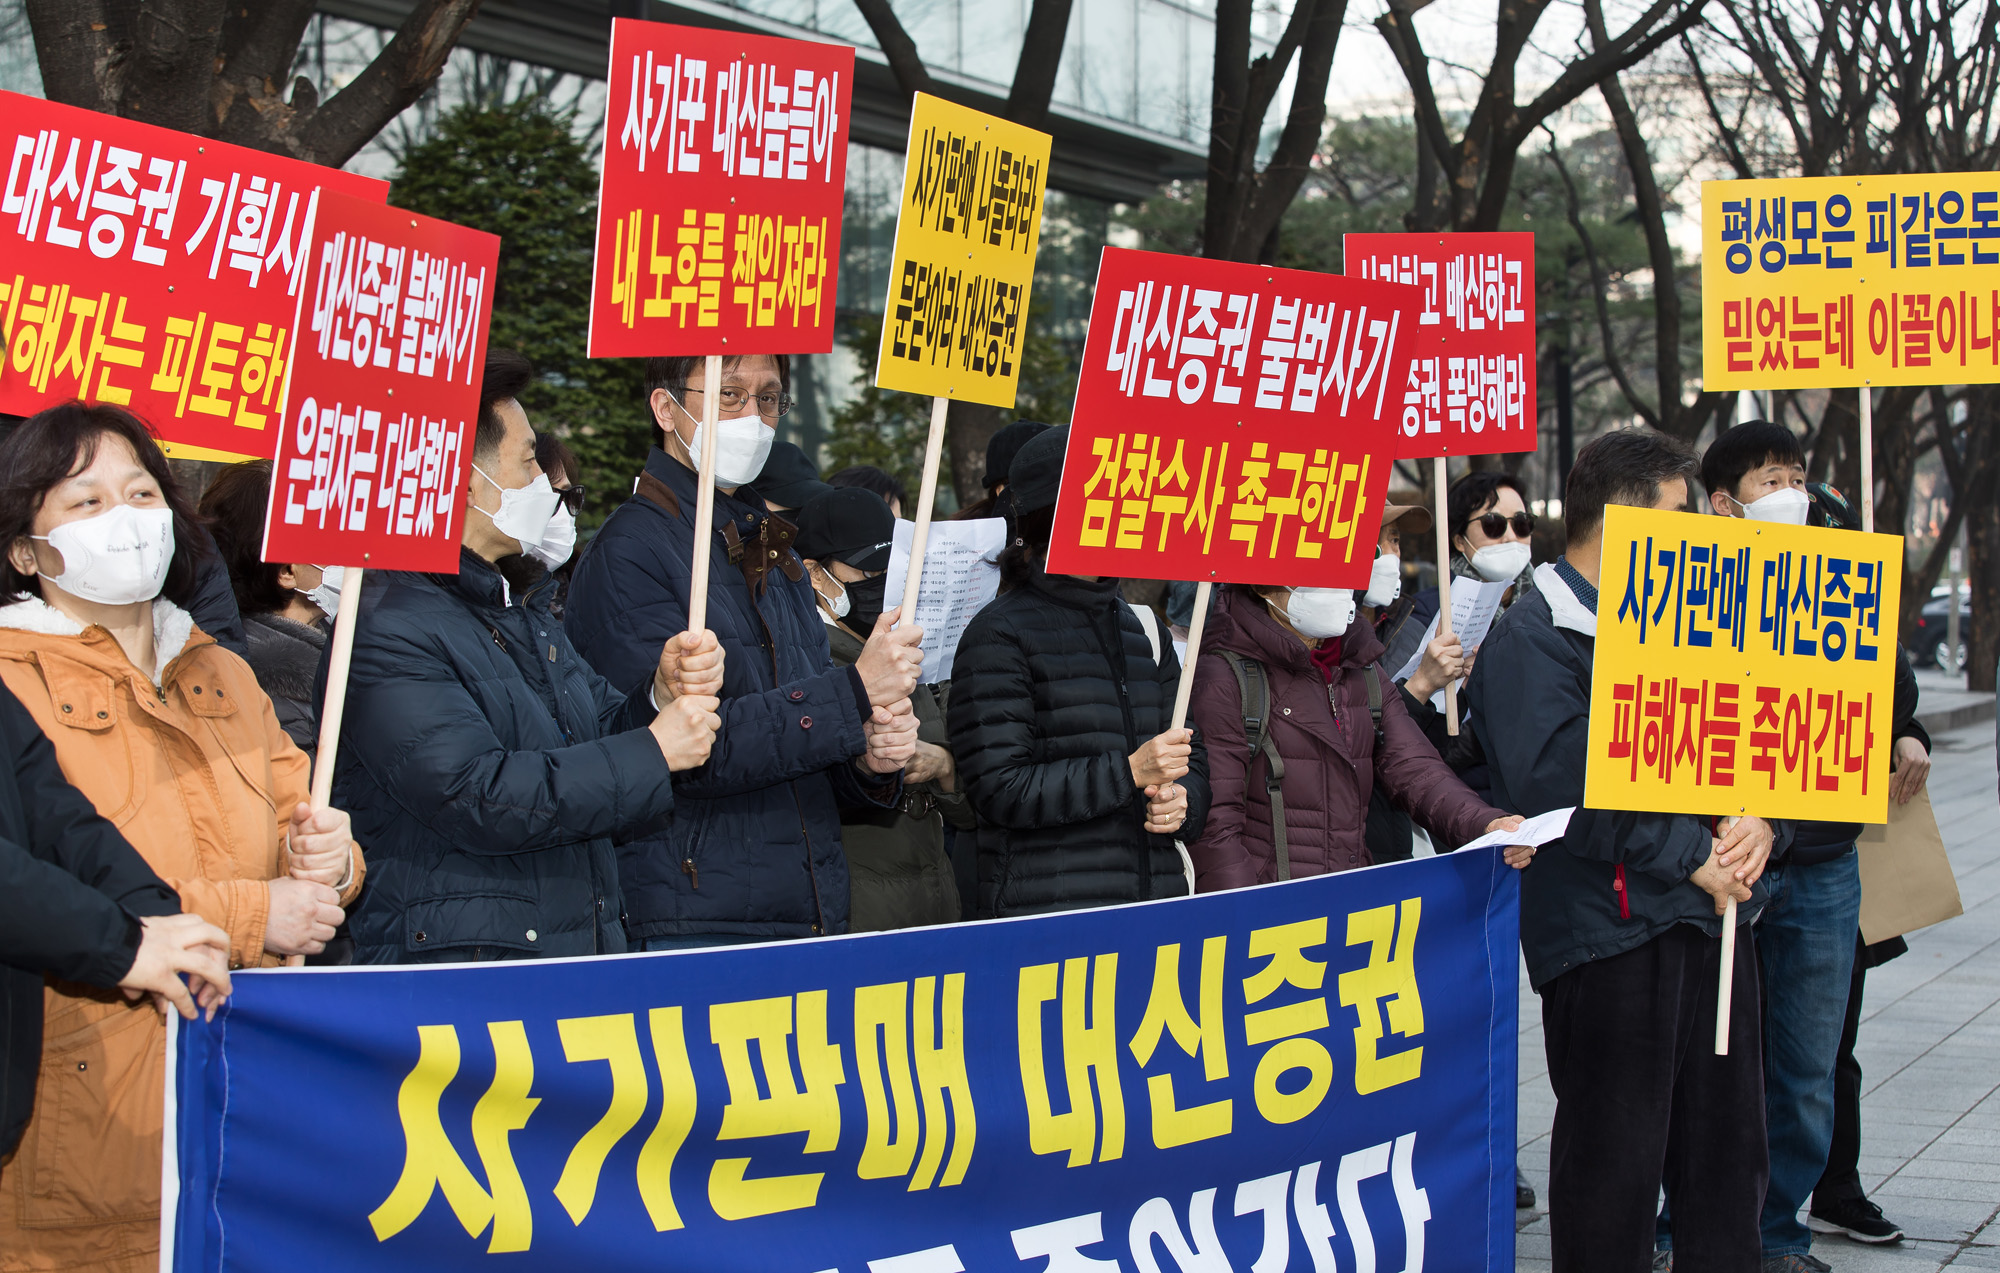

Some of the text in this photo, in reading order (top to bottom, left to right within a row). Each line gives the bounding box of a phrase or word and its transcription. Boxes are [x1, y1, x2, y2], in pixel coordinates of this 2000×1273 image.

[621, 51, 839, 183] 사기꾼 대신놈들아
[1, 129, 187, 267] 대신증권
[912, 126, 1040, 254] 사기판매 나몰라라
[1721, 191, 2000, 275] 평생모은 피같은돈
[311, 231, 486, 385] 대신증권 불법사기
[611, 209, 827, 328] 내 노후를 책임져라
[892, 260, 1023, 378] 문닫아라 대신증권
[1446, 253, 1525, 332] 배신하고
[150, 311, 292, 431] 피토한
[1105, 280, 1259, 405] 대신증권
[1255, 295, 1401, 421] 불법사기
[1399, 353, 1526, 438] 증권 폭망해라
[1724, 294, 1854, 373] 믿었는데
[284, 397, 465, 540] 은퇴자금 다날렸다
[1078, 433, 1371, 563] 검찰수사 촉구한다
[1617, 536, 1751, 653] 사기판매
[1759, 551, 1884, 662] 대신증권
[1608, 674, 1875, 795] 피해자들 죽어간다
[367, 897, 1424, 1254] 사기판매 대신증권
